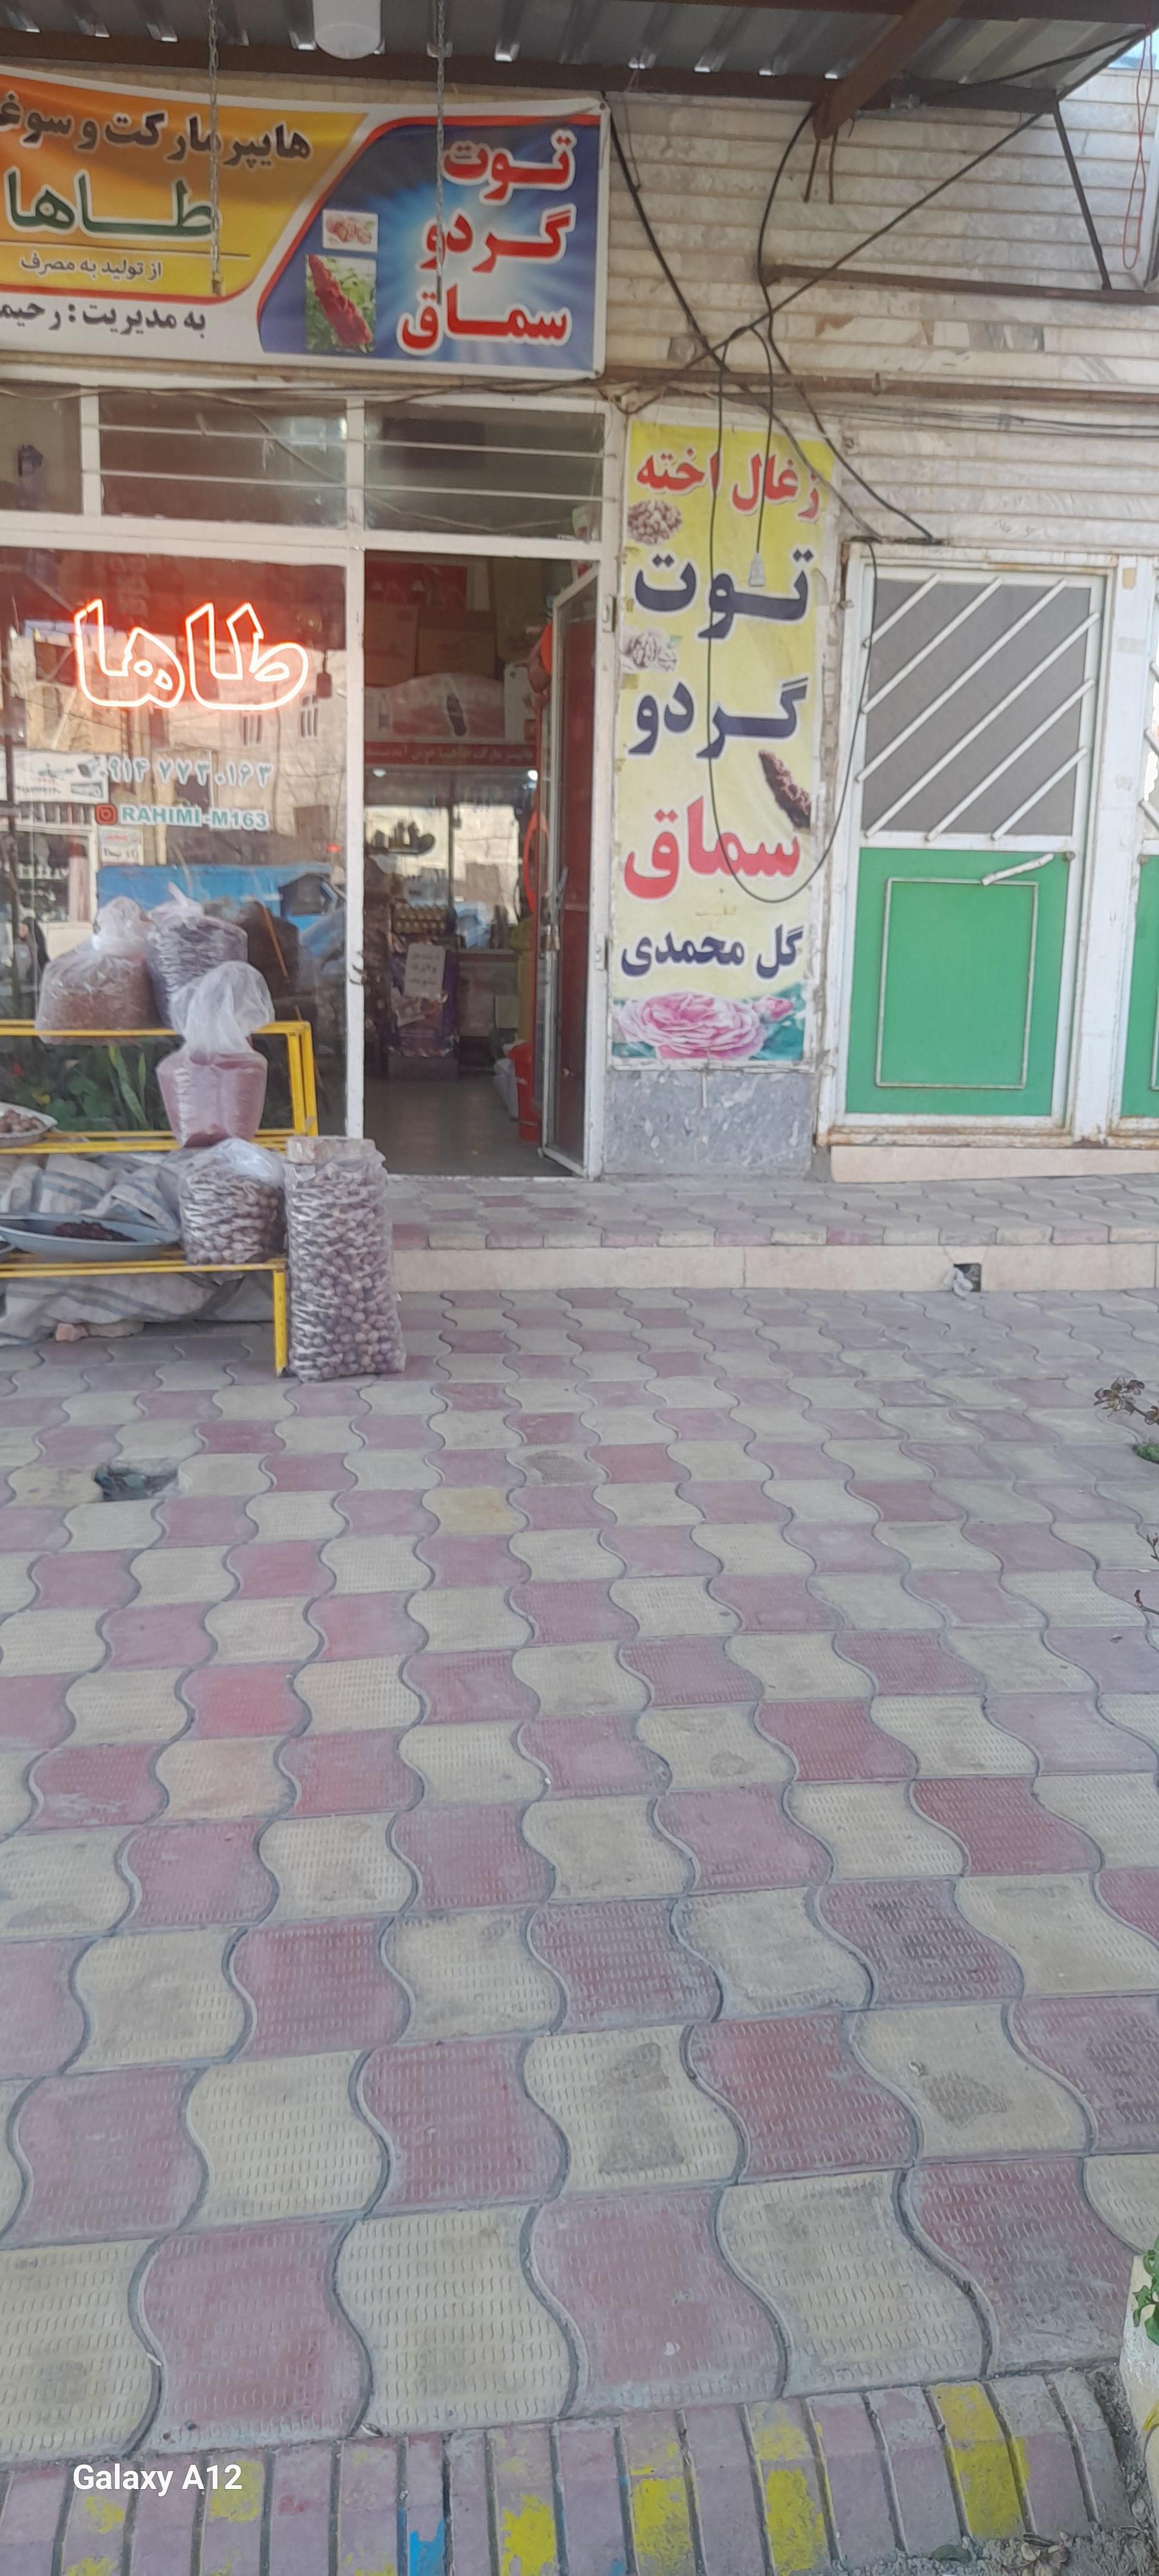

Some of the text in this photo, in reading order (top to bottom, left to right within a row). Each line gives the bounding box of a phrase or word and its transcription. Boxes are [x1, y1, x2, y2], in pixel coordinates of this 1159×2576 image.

[0, 93, 71, 144] سوغ
[77, 120, 97, 150] و
[444, 136, 572, 201] توت
[8, 171, 217, 238] طاها
[21, 253, 161, 281] از تولید به مصرف
[420, 210, 571, 273] گردو
[0, 303, 61, 331] رحیم
[184, 311, 206, 339] به
[401, 284, 567, 350] سماق
[636, 448, 819, 519] زغال اخته
[635, 550, 814, 639] توت
[74, 598, 309, 710] طاها
[628, 677, 808, 759] گردو
[624, 796, 800, 899] سماق
[621, 924, 804, 979] گل محمدی
